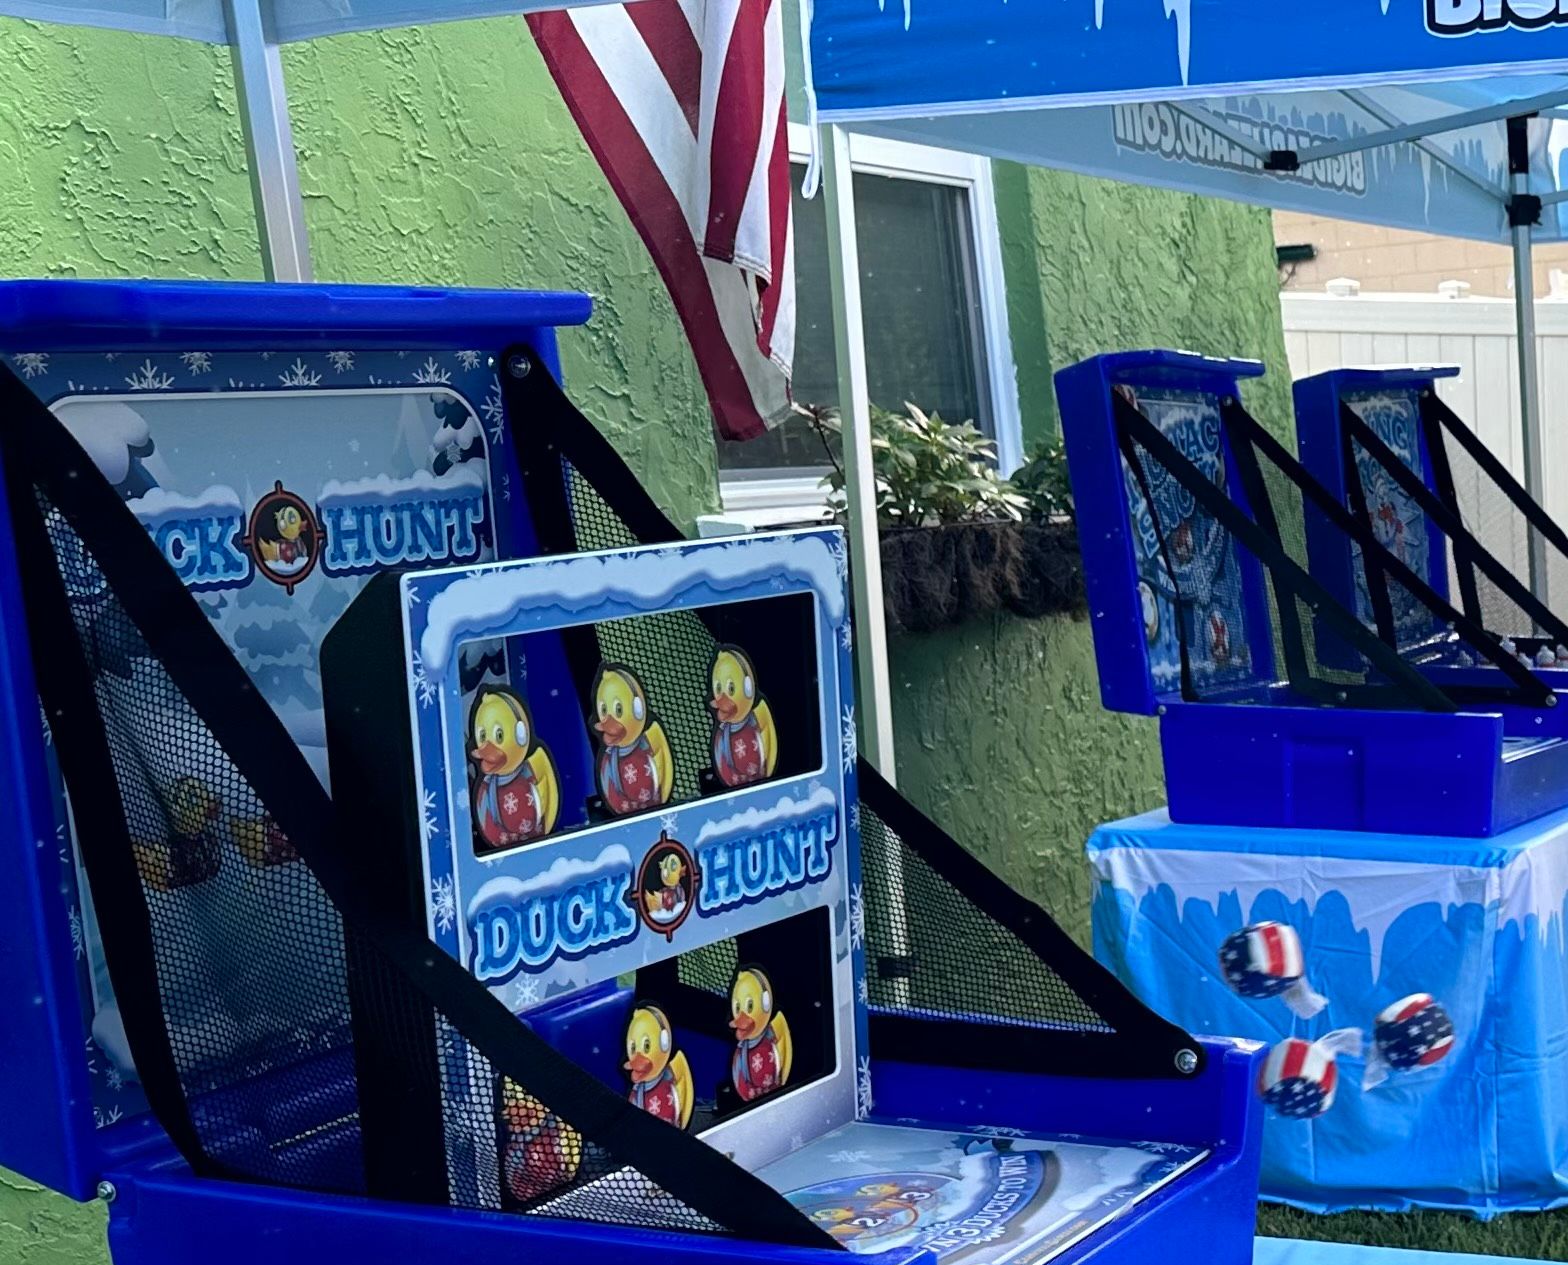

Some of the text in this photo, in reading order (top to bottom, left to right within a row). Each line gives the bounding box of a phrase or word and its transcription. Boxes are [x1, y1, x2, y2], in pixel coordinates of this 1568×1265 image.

[322, 499, 483, 571] HUNT
[474, 814, 837, 981] DUCK HUNT
[999, 1155, 1028, 1177] WIN
[998, 1177, 1027, 1191] TO
[961, 1193, 1020, 1227] DUCKS
[945, 1227, 981, 1237] 3
